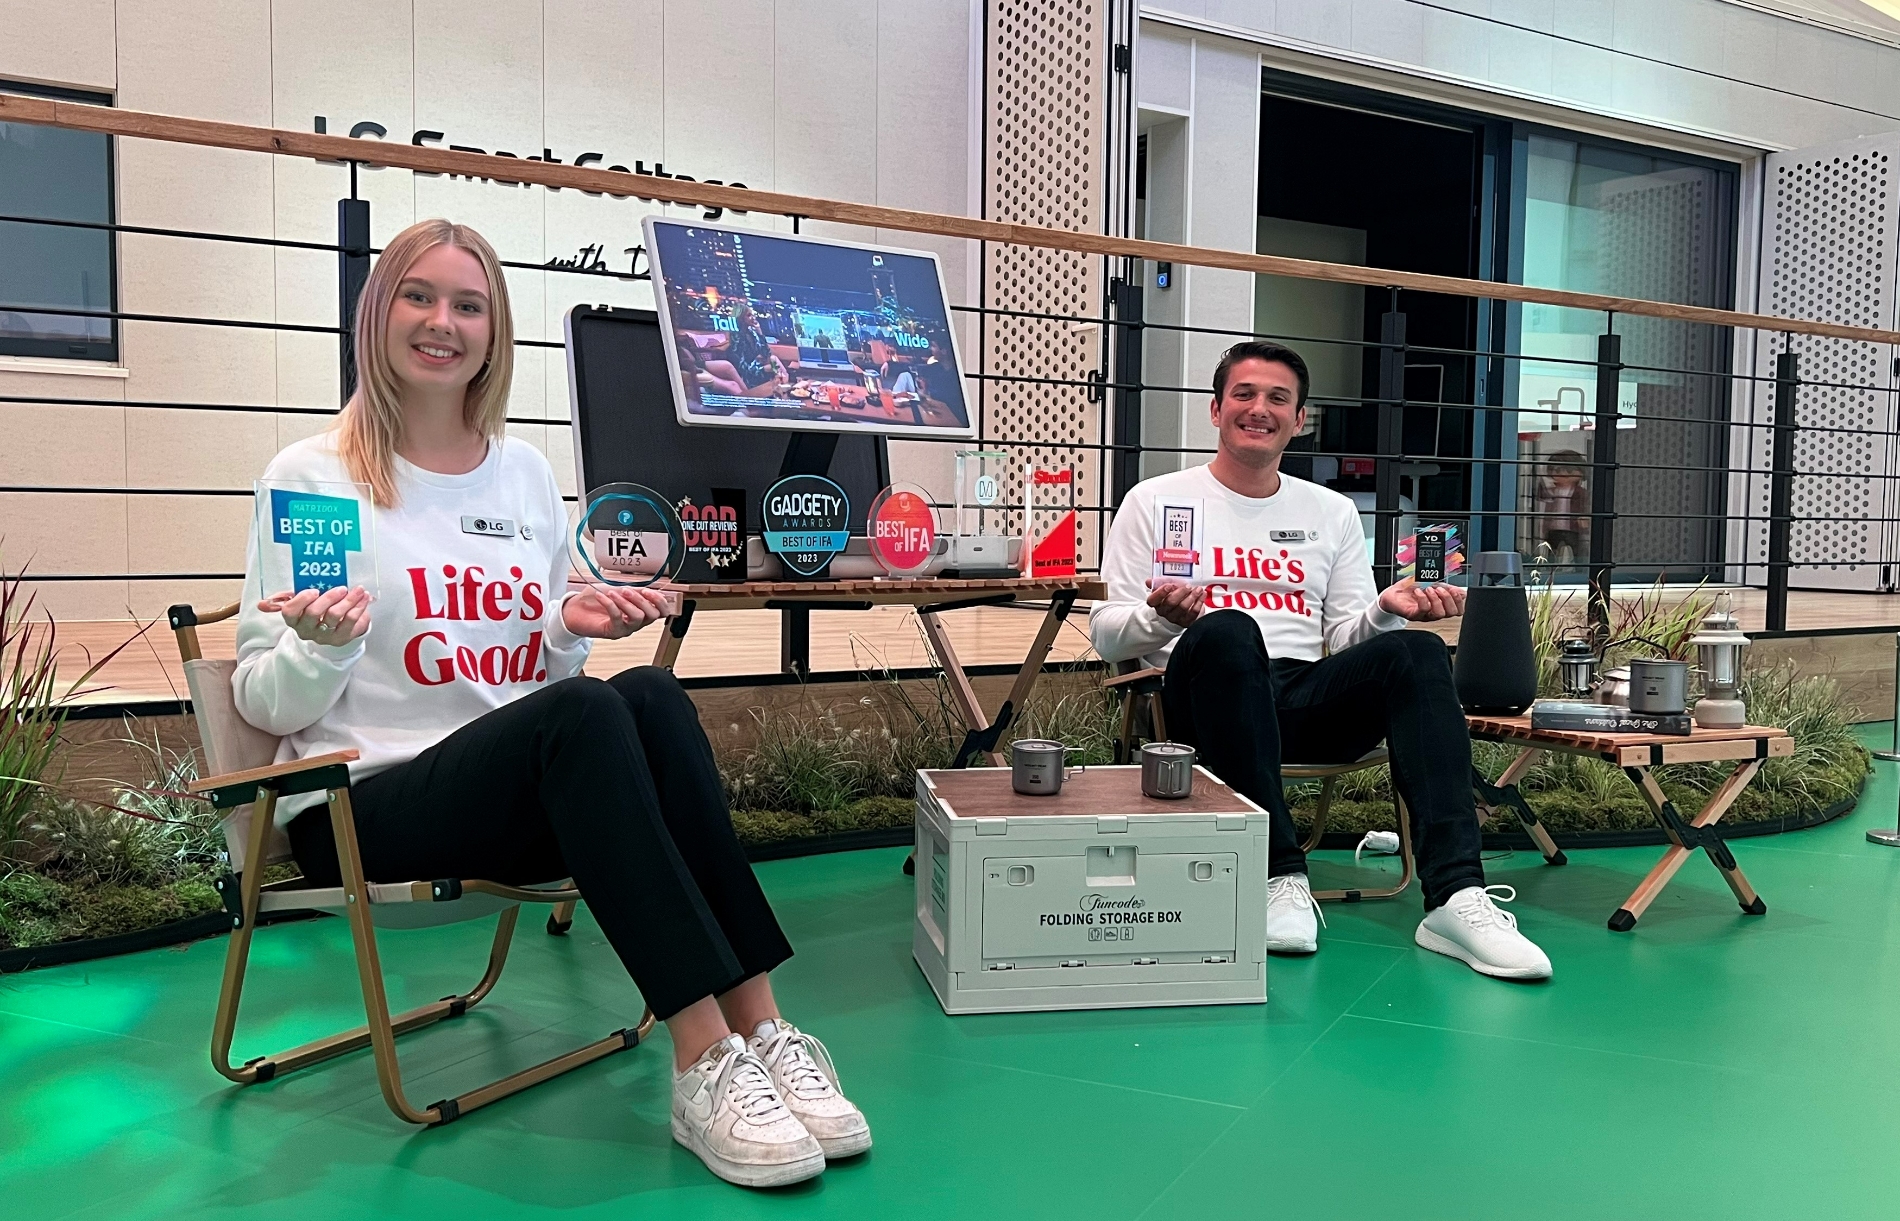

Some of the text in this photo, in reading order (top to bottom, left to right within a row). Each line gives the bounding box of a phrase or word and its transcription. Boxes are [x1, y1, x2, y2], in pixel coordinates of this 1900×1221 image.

[544, 243, 608, 272] with
[709, 314, 739, 333] Tall
[894, 331, 929, 349] Wide
[293, 504, 339, 513] MATRIDOX
[771, 493, 842, 516] GADGETY
[280, 518, 354, 536] BEST OF
[489, 521, 504, 531] LG
[682, 520, 738, 531] ONE CUT REVIEWS
[782, 518, 832, 528] AWARDS
[876, 520, 905, 538] BEST
[1169, 520, 1188, 532] BEST
[782, 536, 833, 548] BEST OF IFA
[904, 527, 931, 552] IFA
[1172, 540, 1183, 548] IFA
[303, 541, 335, 556] IFA
[608, 537, 648, 558] IFA
[894, 542, 903, 552] OF
[1419, 549, 1441, 558] BEST OF
[612, 557, 641, 566] 2023
[797, 553, 818, 563] 2023
[1424, 558, 1436, 568] IFA
[299, 562, 341, 577] 2023
[1170, 563, 1185, 571] 2023
[1212, 546, 1305, 584] Life's
[1420, 569, 1439, 579] 2023
[406, 564, 544, 621] Life's
[1205, 583, 1312, 617] Good.
[404, 630, 547, 686] Good.
[1584, 718, 1659, 729] The Great Outdoors
[1040, 911, 1182, 926] FOLDING STORAGE BOX
